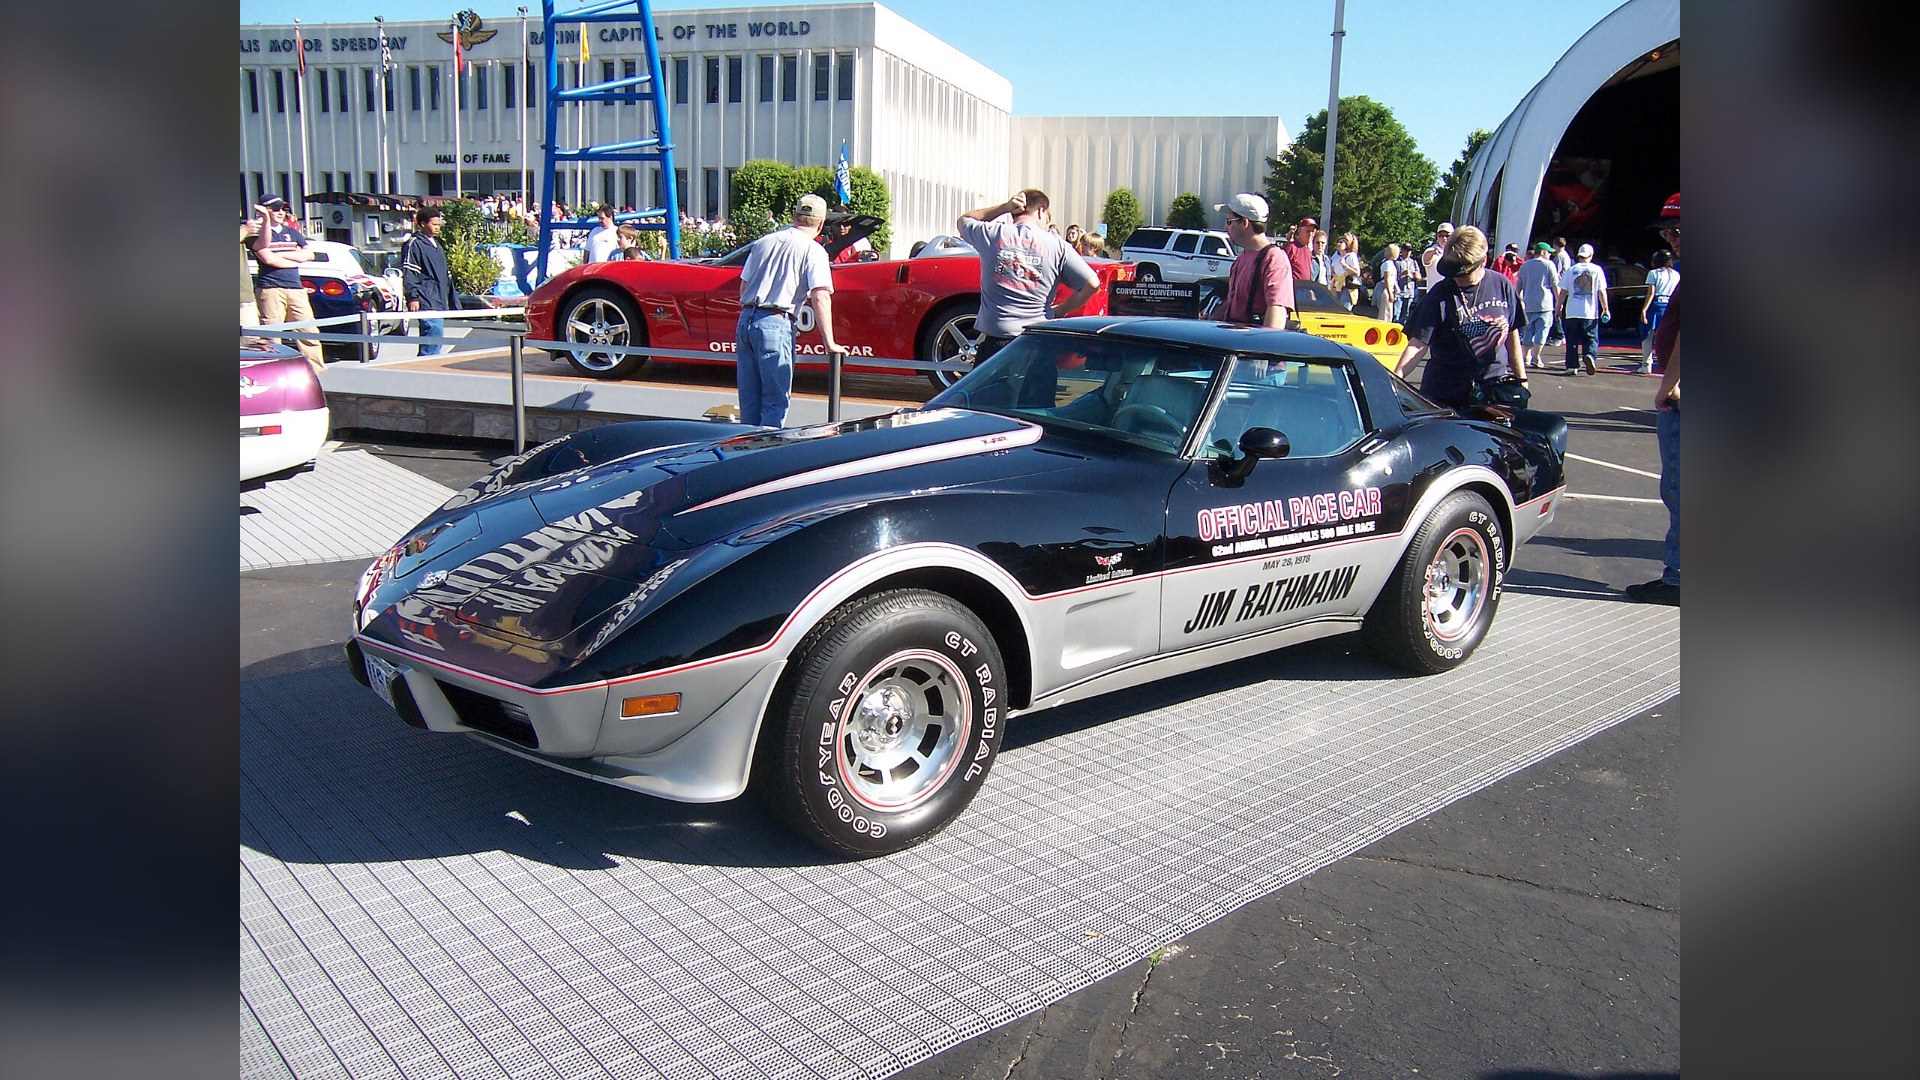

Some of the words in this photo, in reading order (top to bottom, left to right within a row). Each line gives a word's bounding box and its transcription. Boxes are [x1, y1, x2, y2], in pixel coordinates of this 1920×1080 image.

[599, 27, 663, 42] CAPITL
[673, 25, 696, 40] OF
[705, 24, 737, 38] THE
[747, 20, 811, 37] WORLD
[463, 154, 478, 163] OF
[482, 153, 511, 163] FAME
[1116, 288, 1149, 296] CORVETTE
[1149, 288, 1193, 298] CONVERTIBLE
[1457, 296, 1508, 324] America
[795, 344, 829, 355] PAC
[1197, 499, 1290, 542] OFFICIAL
[1288, 493, 1339, 528] PACE
[1338, 487, 1382, 520] CAR
[1212, 543, 1234, 557] 62nd
[1266, 529, 1320, 549] INDIANAPOLIS
[1320, 526, 1336, 540] 500
[1336, 522, 1354, 537] MILE
[1354, 520, 1376, 534] RACE
[1262, 560, 1280, 571] MAY
[1469, 511, 1487, 524] GT
[1486, 522, 1503, 601] RADIAL
[1184, 588, 1238, 634] JIM
[1235, 564, 1361, 622] RATHMANN
[945, 631, 977, 658] GT
[964, 663, 997, 782] RADIAL
[818, 672, 887, 839] GOODYEAR
